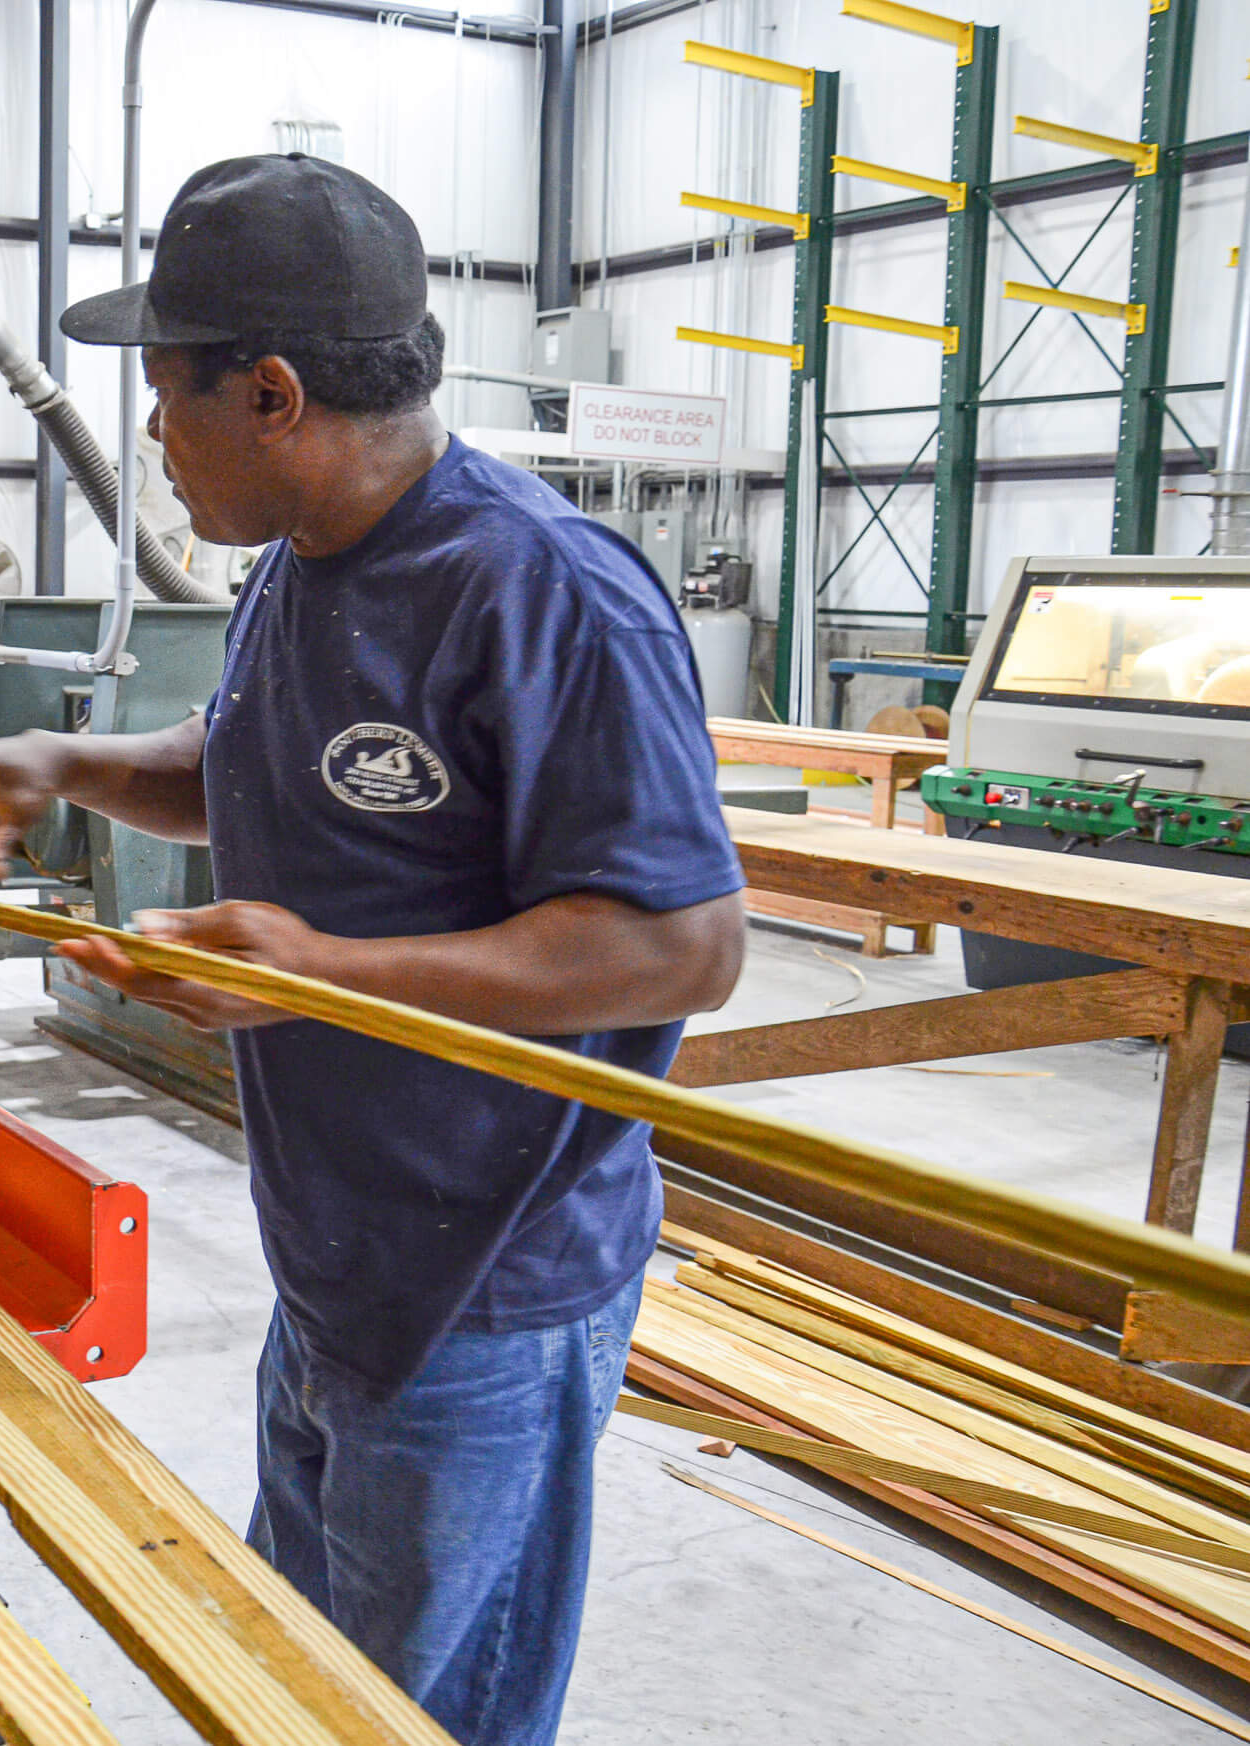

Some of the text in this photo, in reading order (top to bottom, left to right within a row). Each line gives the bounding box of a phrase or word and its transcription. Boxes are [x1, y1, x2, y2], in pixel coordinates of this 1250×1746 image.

[584, 403, 715, 427] CLEARANCE AREA
[593, 424, 703, 446] DO NOT BLOCK
